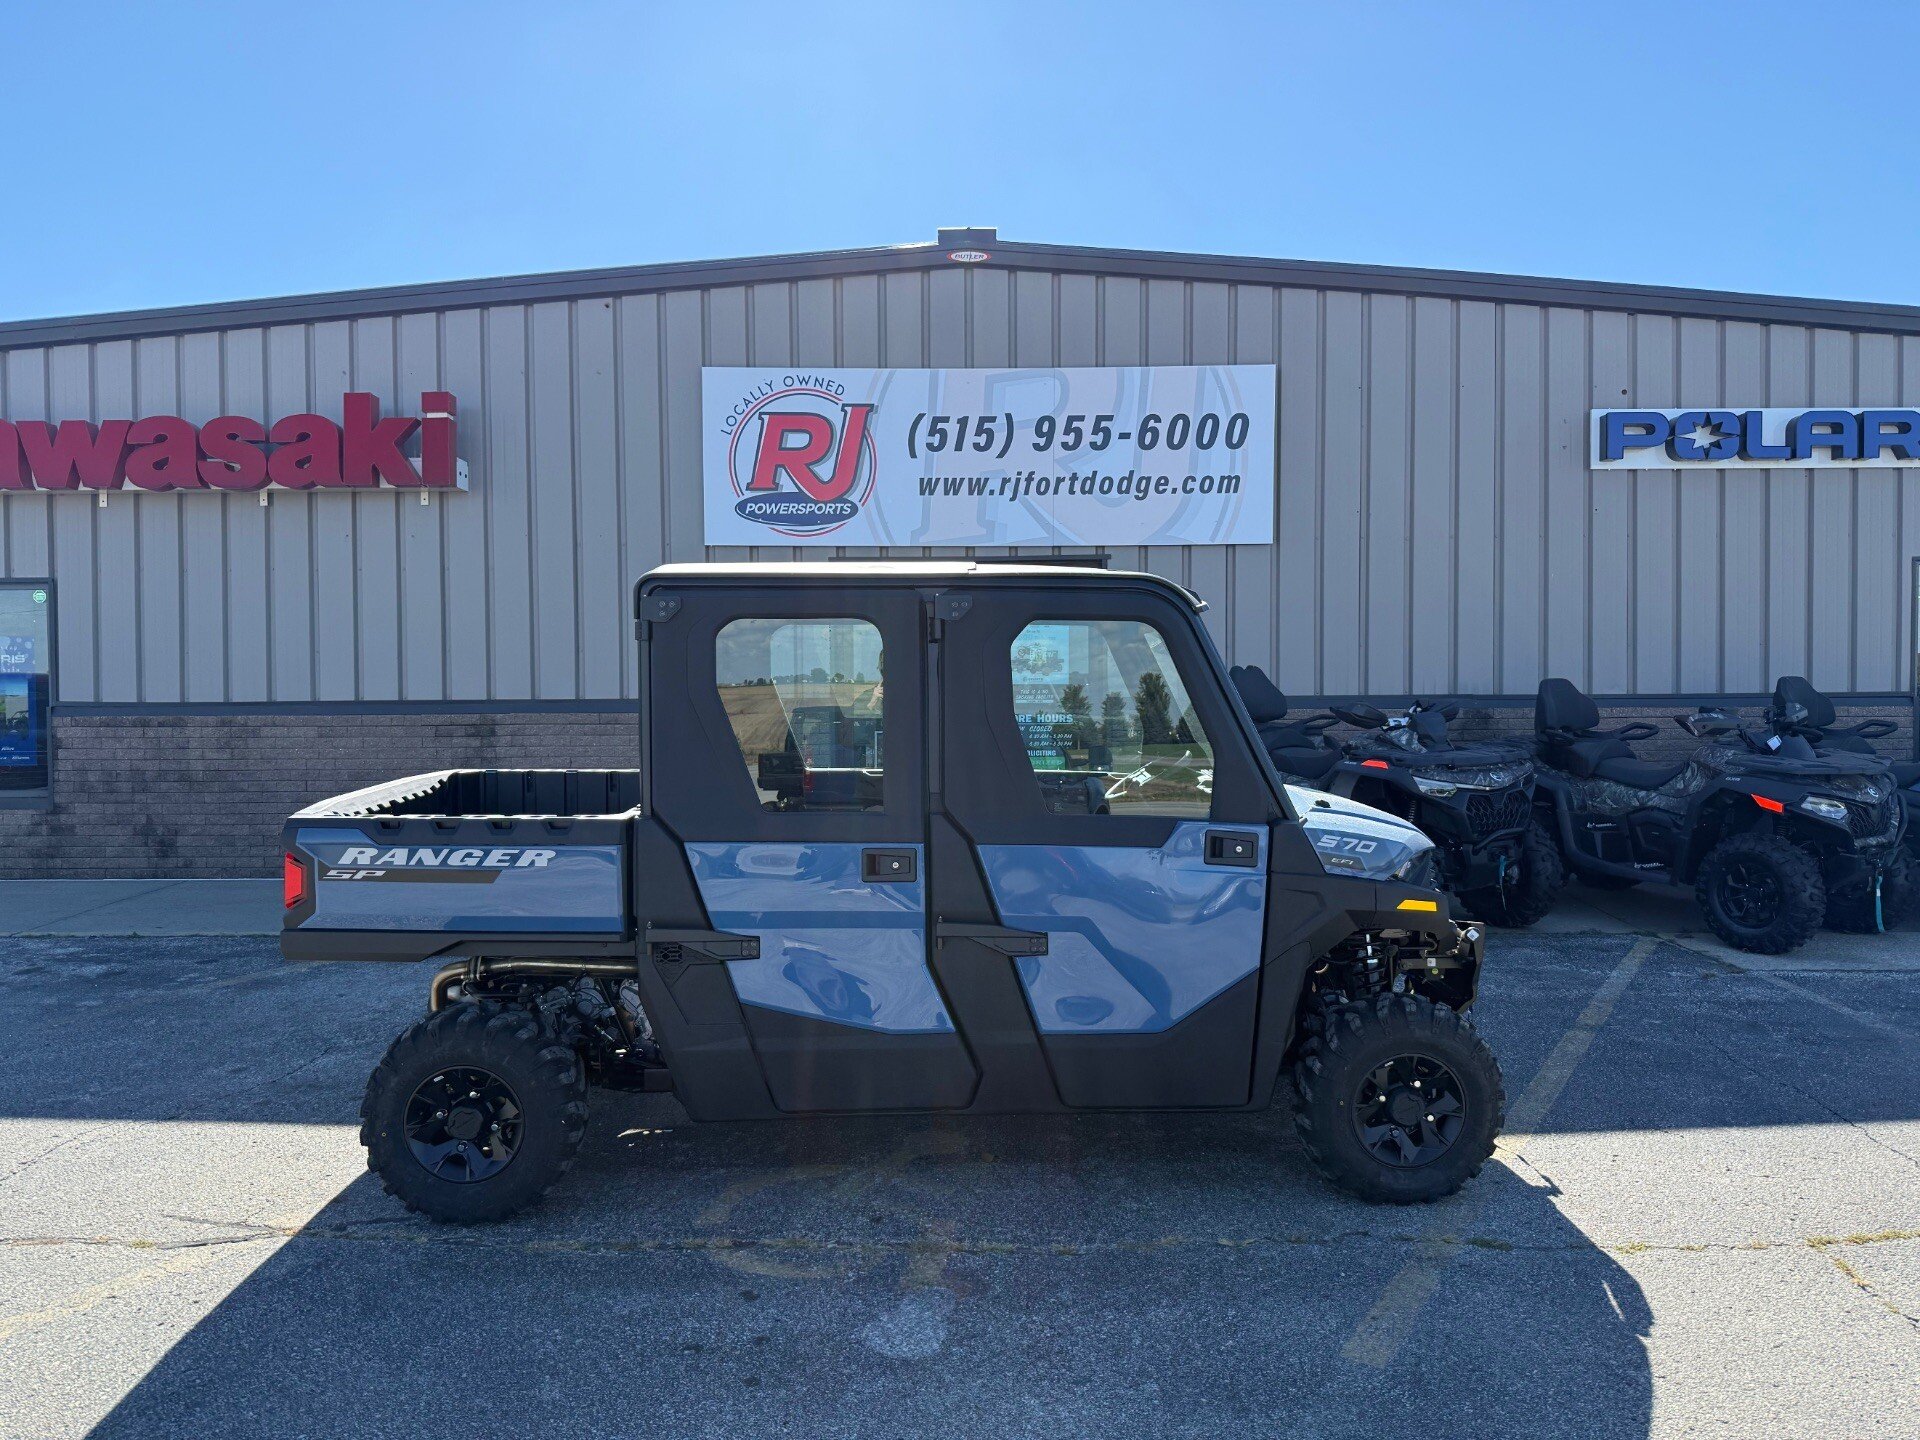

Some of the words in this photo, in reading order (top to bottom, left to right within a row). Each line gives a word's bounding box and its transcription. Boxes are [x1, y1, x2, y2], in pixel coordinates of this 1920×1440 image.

[720, 380, 774, 436] LOCALLY
[783, 374, 846, 397] OWNED
[907, 413, 1015, 459] (515)
[1031, 412, 1250, 452] 955-6000
[745, 403, 875, 502] RJ
[918, 470, 1242, 502] www.rjfortdodge.com
[745, 502, 852, 516] POWERSPORTS
[1036, 713, 1074, 723] HOURS
[1317, 834, 1378, 853] 570
[338, 847, 556, 868] RANGER
[323, 869, 387, 880] SP
